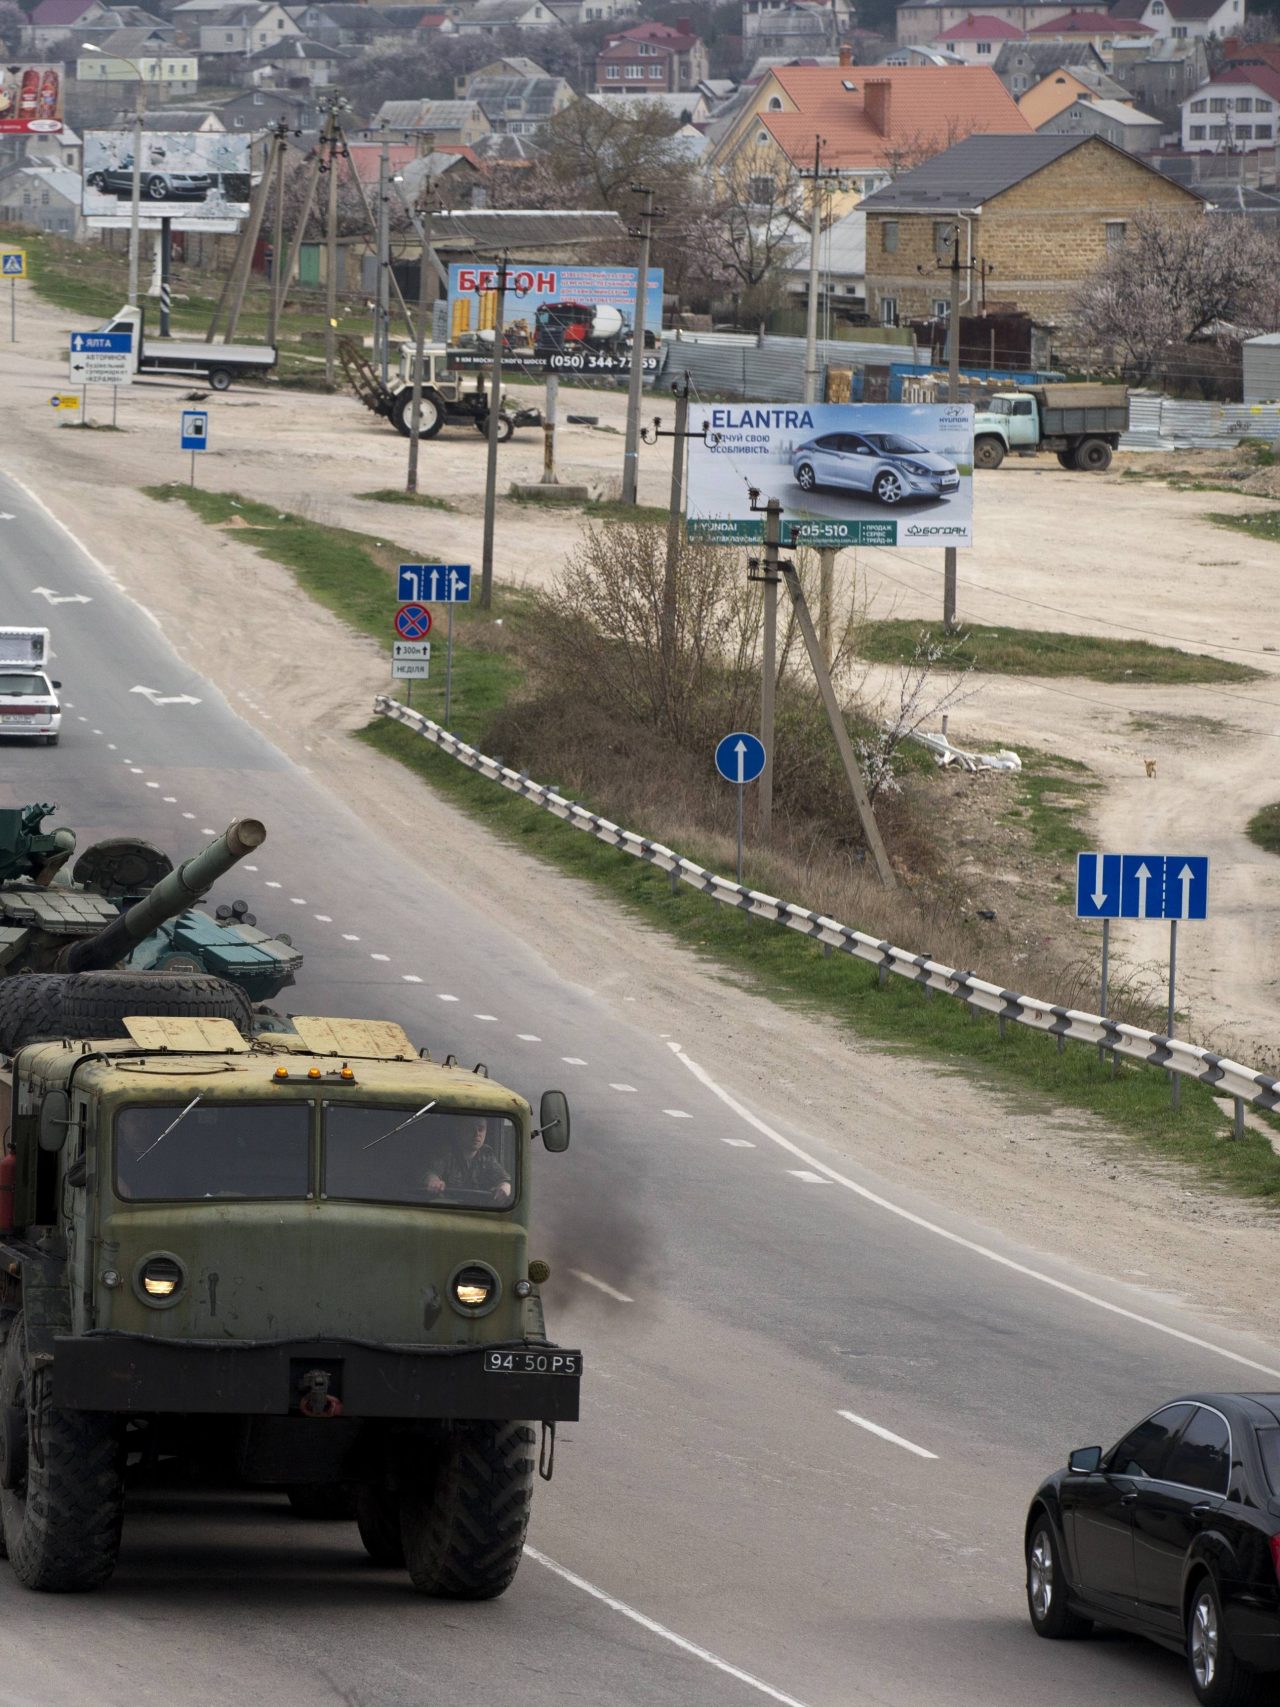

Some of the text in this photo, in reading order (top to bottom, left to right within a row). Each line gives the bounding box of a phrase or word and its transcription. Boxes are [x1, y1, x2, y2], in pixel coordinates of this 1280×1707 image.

[458, 269, 556, 293] БЕТОН
[85, 338, 112, 348] ЯЛТА
[550, 354, 584, 368] (050)
[588, 356, 657, 368] 344-7759
[712, 410, 814, 428] ELANTRA
[710, 432, 770, 443] ВДЧУЙ СВОЮ
[710, 445, 769, 455] ОСОБЛИВІСТЬ
[403, 646, 421, 655] 300м
[491, 1354, 513, 1370] 94
[524, 1355, 548, 1371] 50
